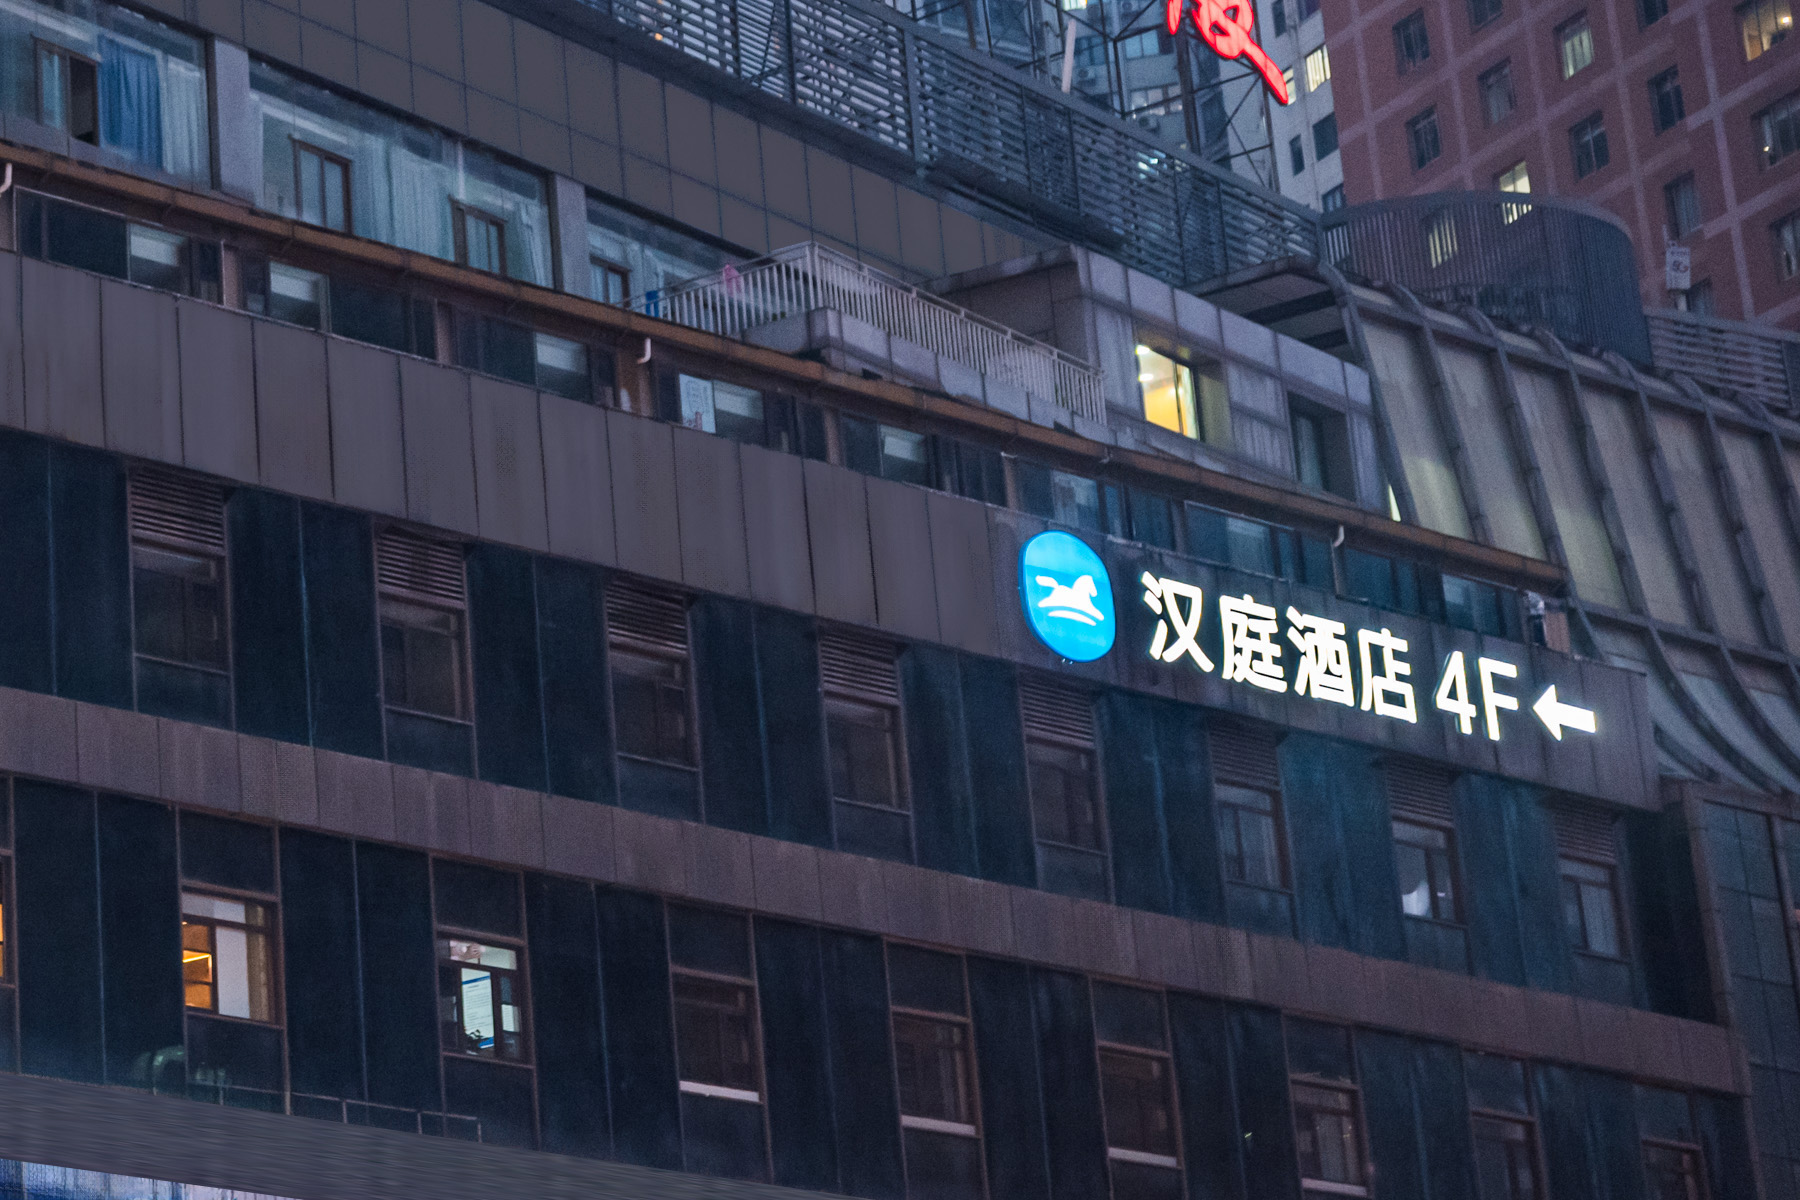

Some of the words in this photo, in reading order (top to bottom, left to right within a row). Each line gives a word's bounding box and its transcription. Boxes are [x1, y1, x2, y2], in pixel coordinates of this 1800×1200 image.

[1141, 570, 1418, 725] 汉庭酒店
[1434, 649, 1519, 742] 4F
